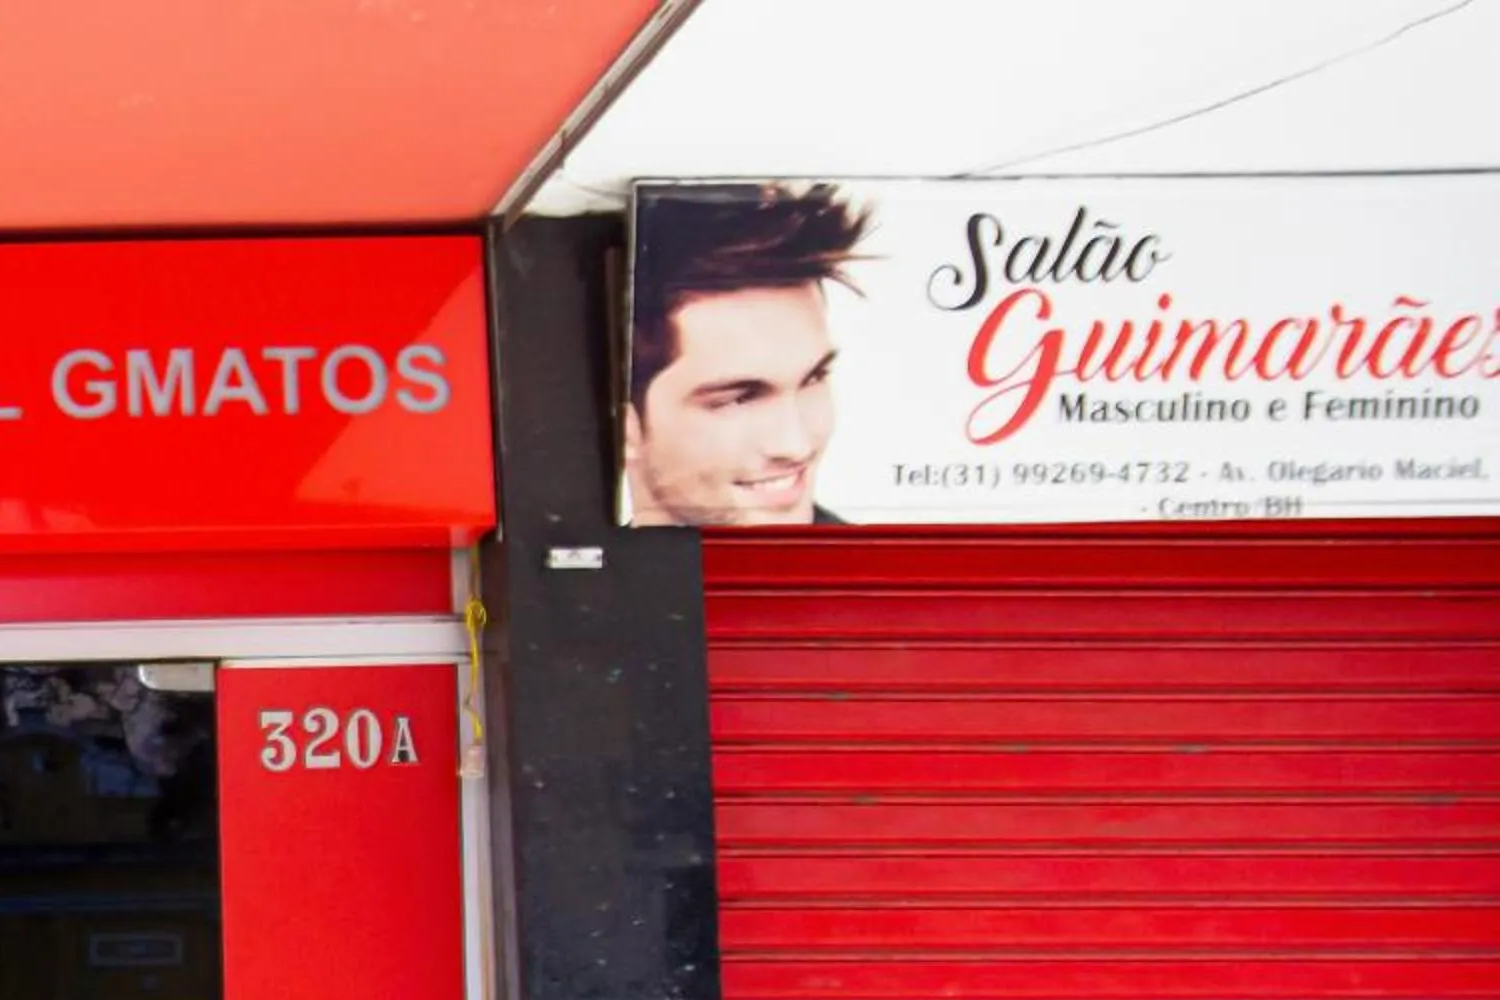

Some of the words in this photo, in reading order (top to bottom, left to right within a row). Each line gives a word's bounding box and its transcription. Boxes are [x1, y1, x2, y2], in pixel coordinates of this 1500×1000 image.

[926, 205, 1173, 311] Salão
[50, 343, 451, 421] GMATOS
[1058, 391, 1252, 424] Masculino
[1267, 398, 1287, 421] e
[1302, 388, 1481, 420] Feminino
[1011, 460, 1192, 486] 99269-4732
[259, 706, 420, 773] 320A
